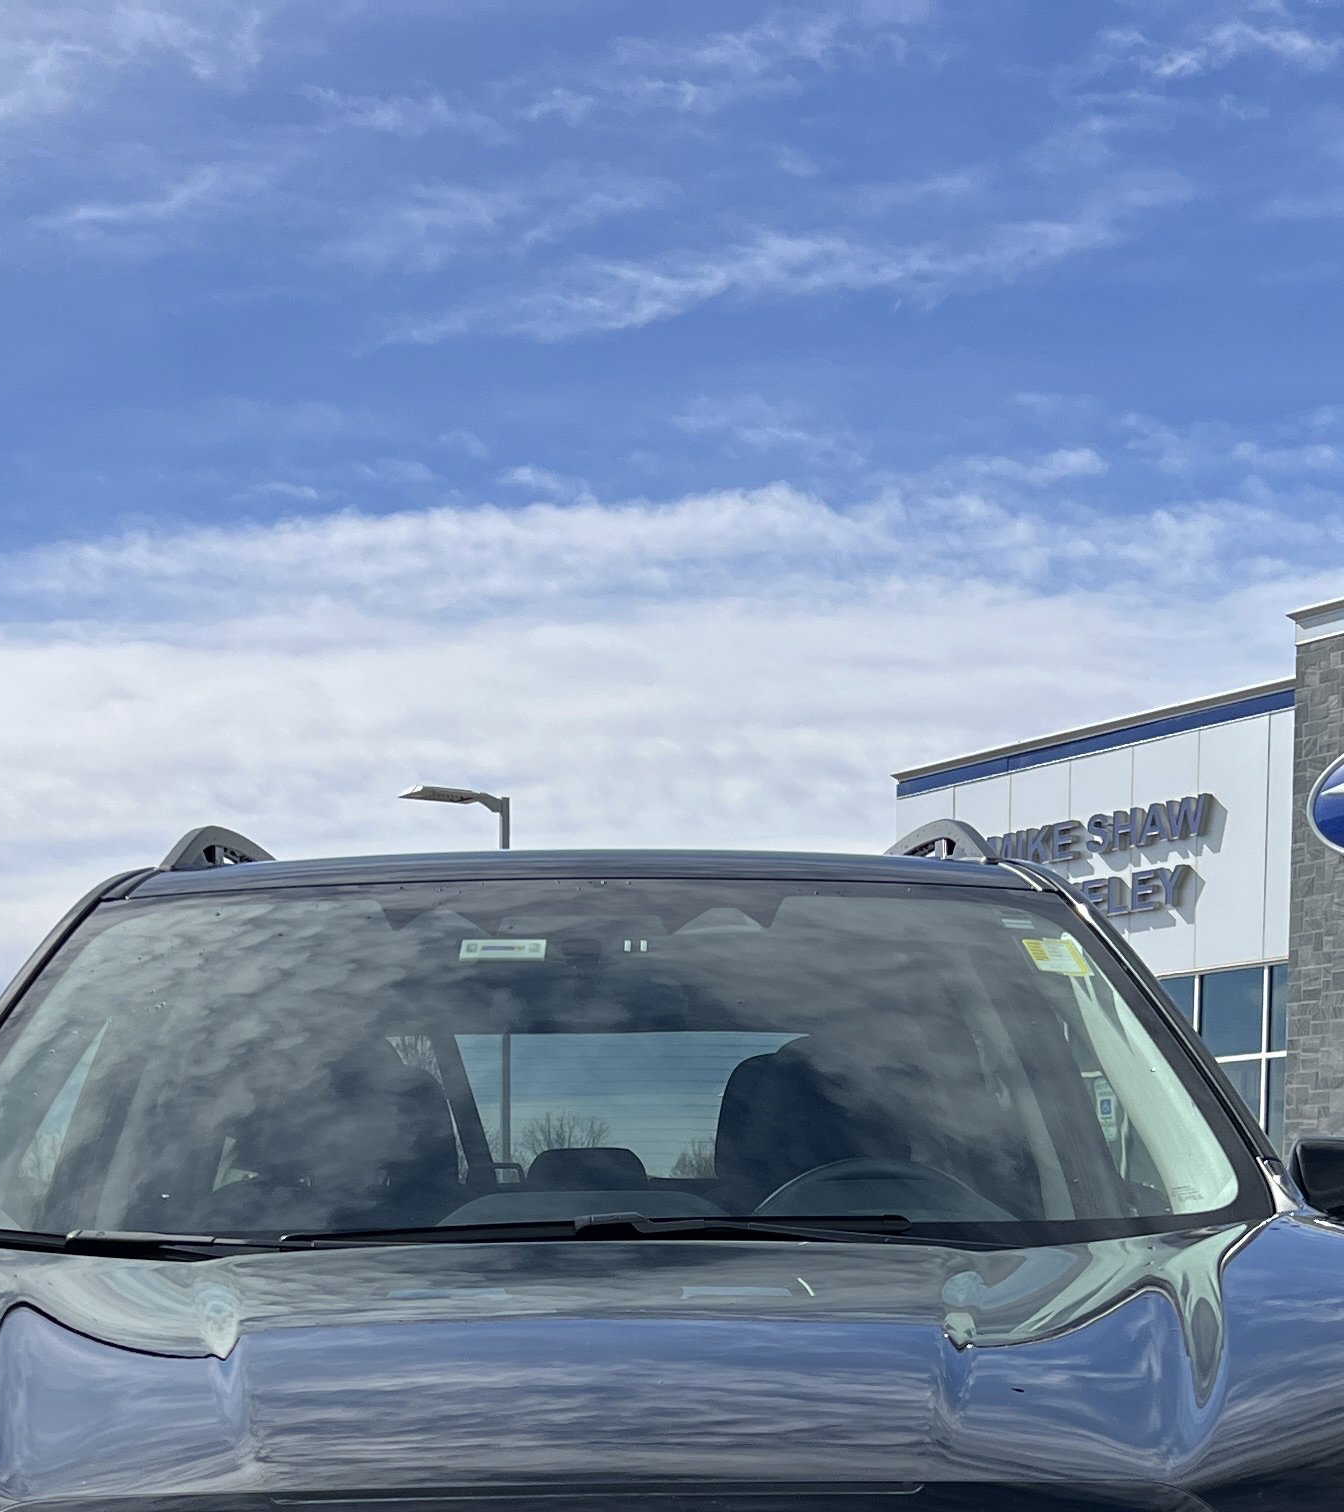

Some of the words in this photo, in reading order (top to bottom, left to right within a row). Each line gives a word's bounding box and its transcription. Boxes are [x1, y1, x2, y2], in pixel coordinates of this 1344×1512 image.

[987, 820, 1080, 865] MIKE
[1087, 793, 1212, 853] SHAW
[1076, 864, 1192, 917] ELEY
